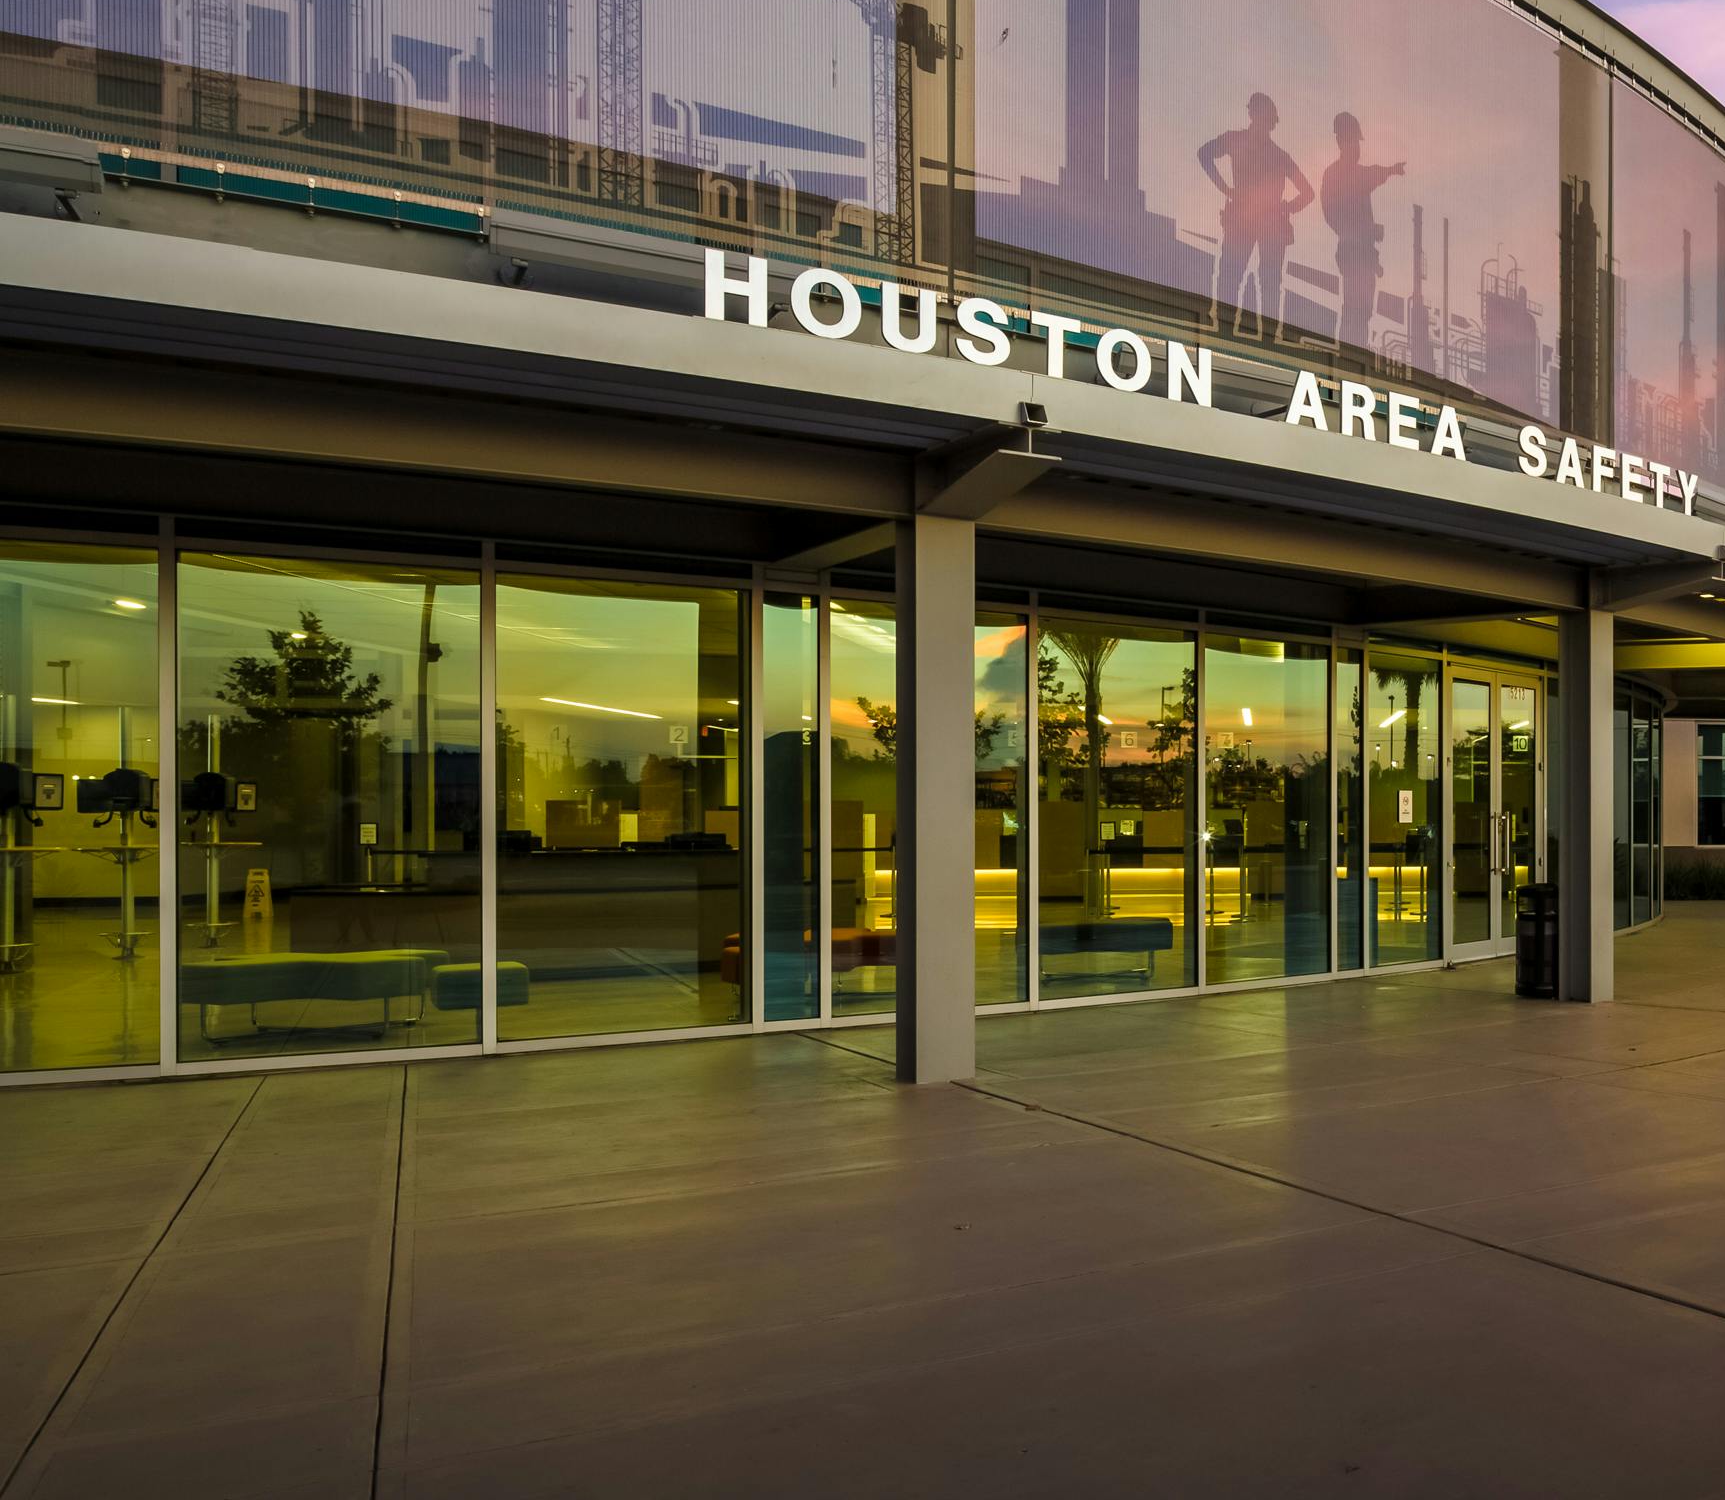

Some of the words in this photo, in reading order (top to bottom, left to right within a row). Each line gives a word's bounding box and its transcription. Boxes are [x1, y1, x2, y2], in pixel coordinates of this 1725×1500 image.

[704, 248, 1212, 407] HOUSTON
[1285, 370, 1466, 461] AREA
[1518, 425, 1698, 516] SAFETY
[674, 727, 685, 742] 2
[1125, 733, 1135, 747] 6
[1513, 737, 1528, 750] 10
